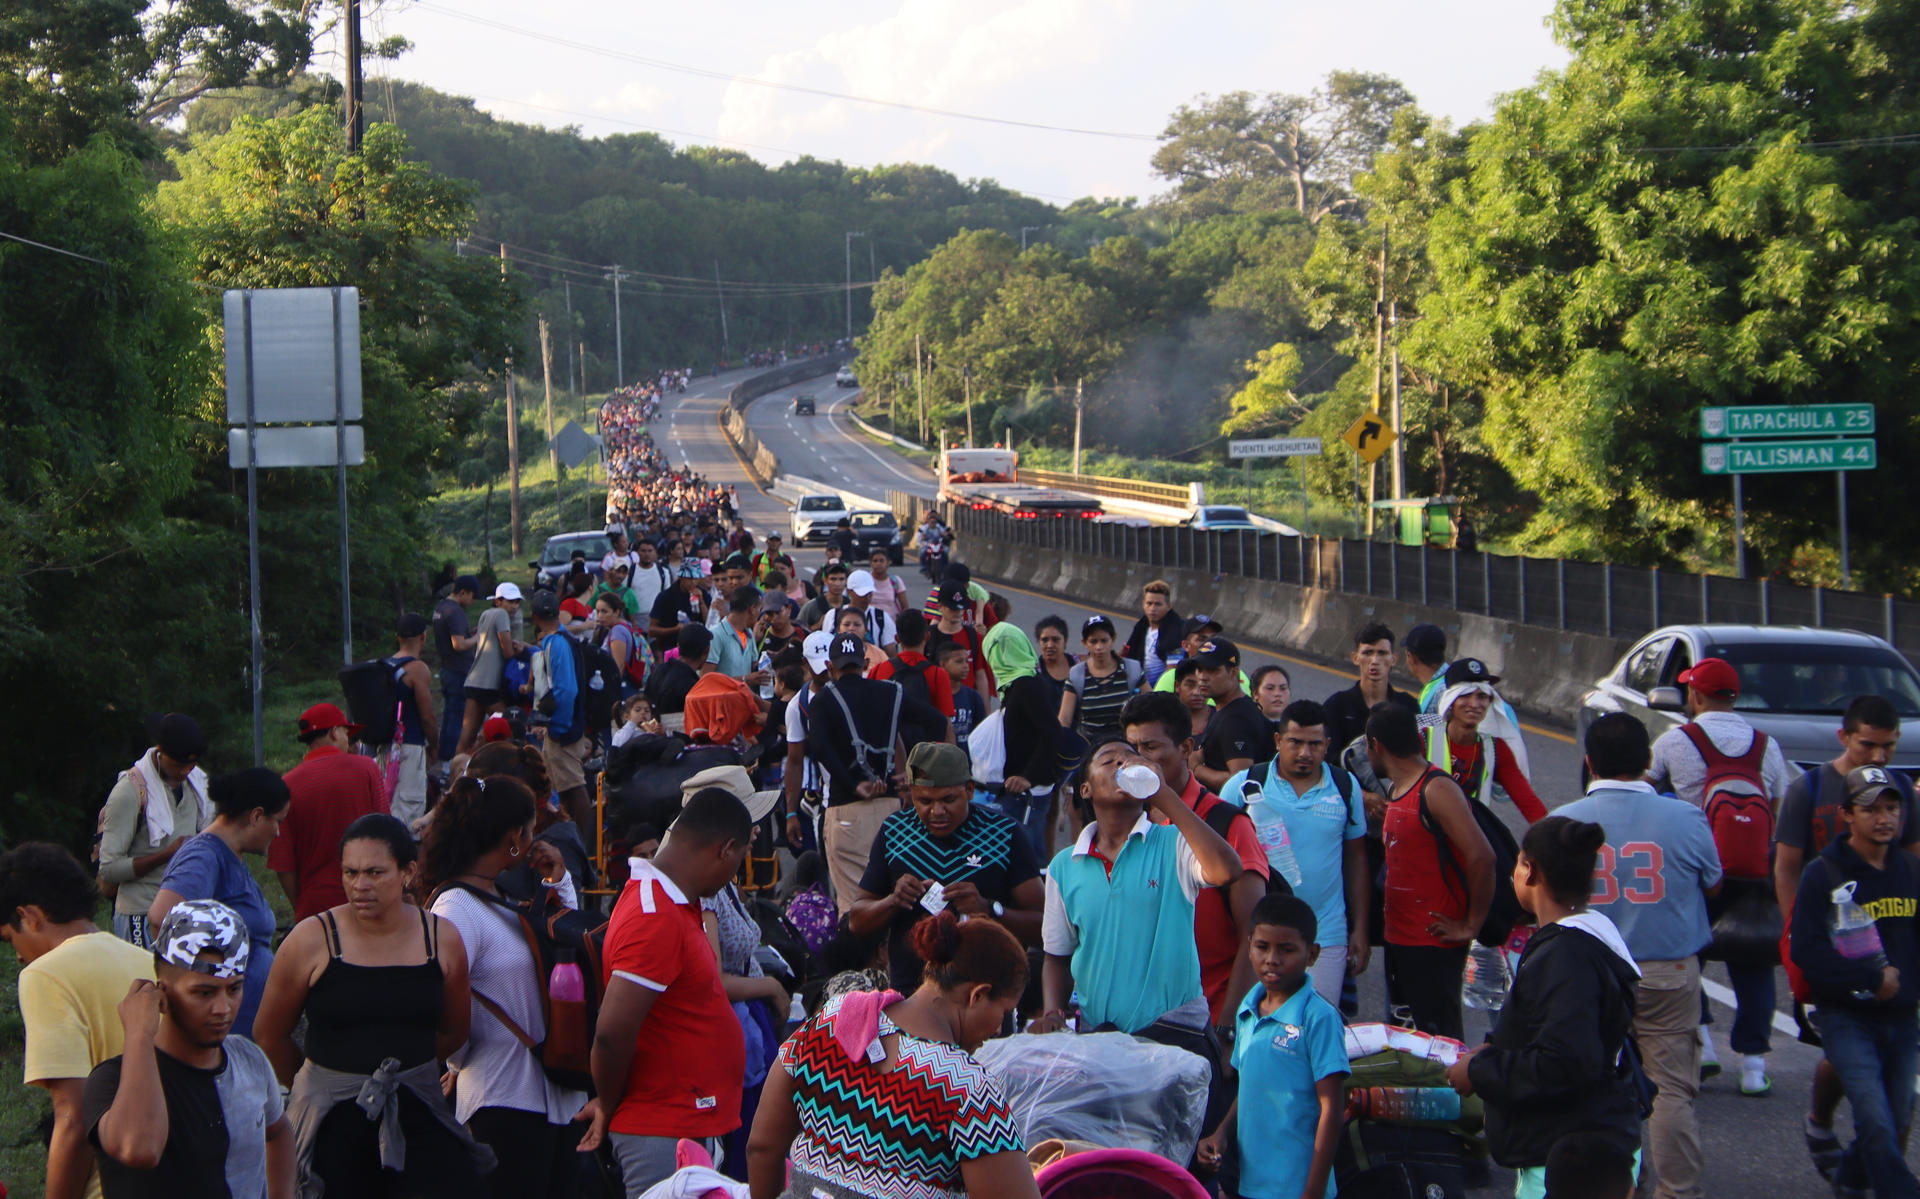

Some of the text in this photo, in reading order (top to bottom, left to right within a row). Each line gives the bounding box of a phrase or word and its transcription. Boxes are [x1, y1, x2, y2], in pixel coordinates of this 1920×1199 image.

[1732, 410, 1871, 430] TAPACHULA 25
[1233, 442, 1318, 454] PUENTE HUEHUETAN
[1732, 446, 1870, 466] TALISMAN 44
[132, 914, 143, 948] SPOR
